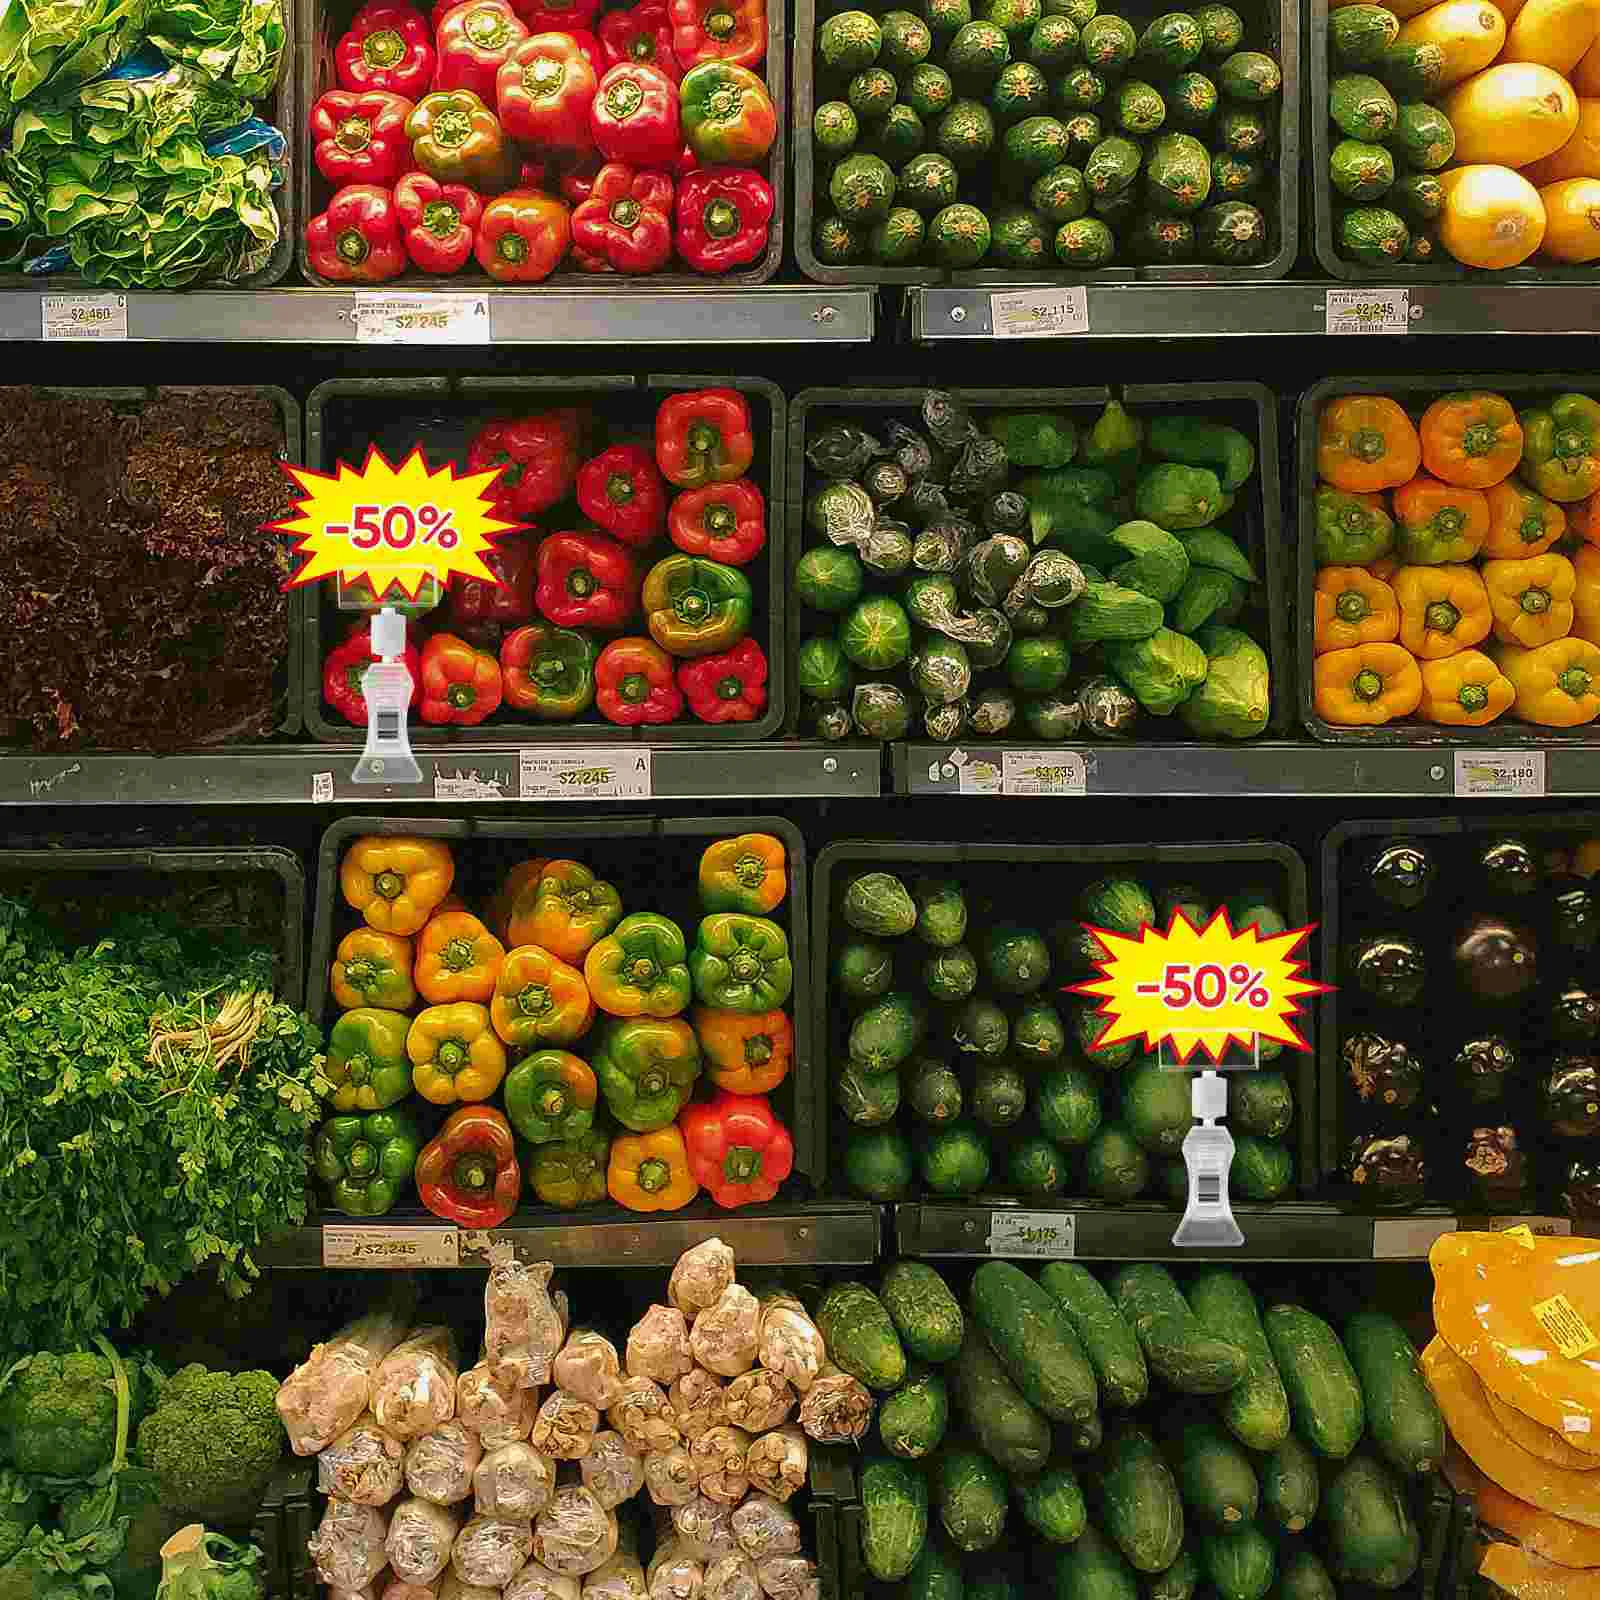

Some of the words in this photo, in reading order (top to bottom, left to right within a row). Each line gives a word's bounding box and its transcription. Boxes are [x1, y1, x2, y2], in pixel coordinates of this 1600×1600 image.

[474, 302, 486, 316] A
[326, 505, 458, 549] -50%
[635, 758, 646, 771] A
[559, 771, 609, 785] $2,245
[1137, 964, 1269, 1008] -50%
[443, 1233, 454, 1246] A
